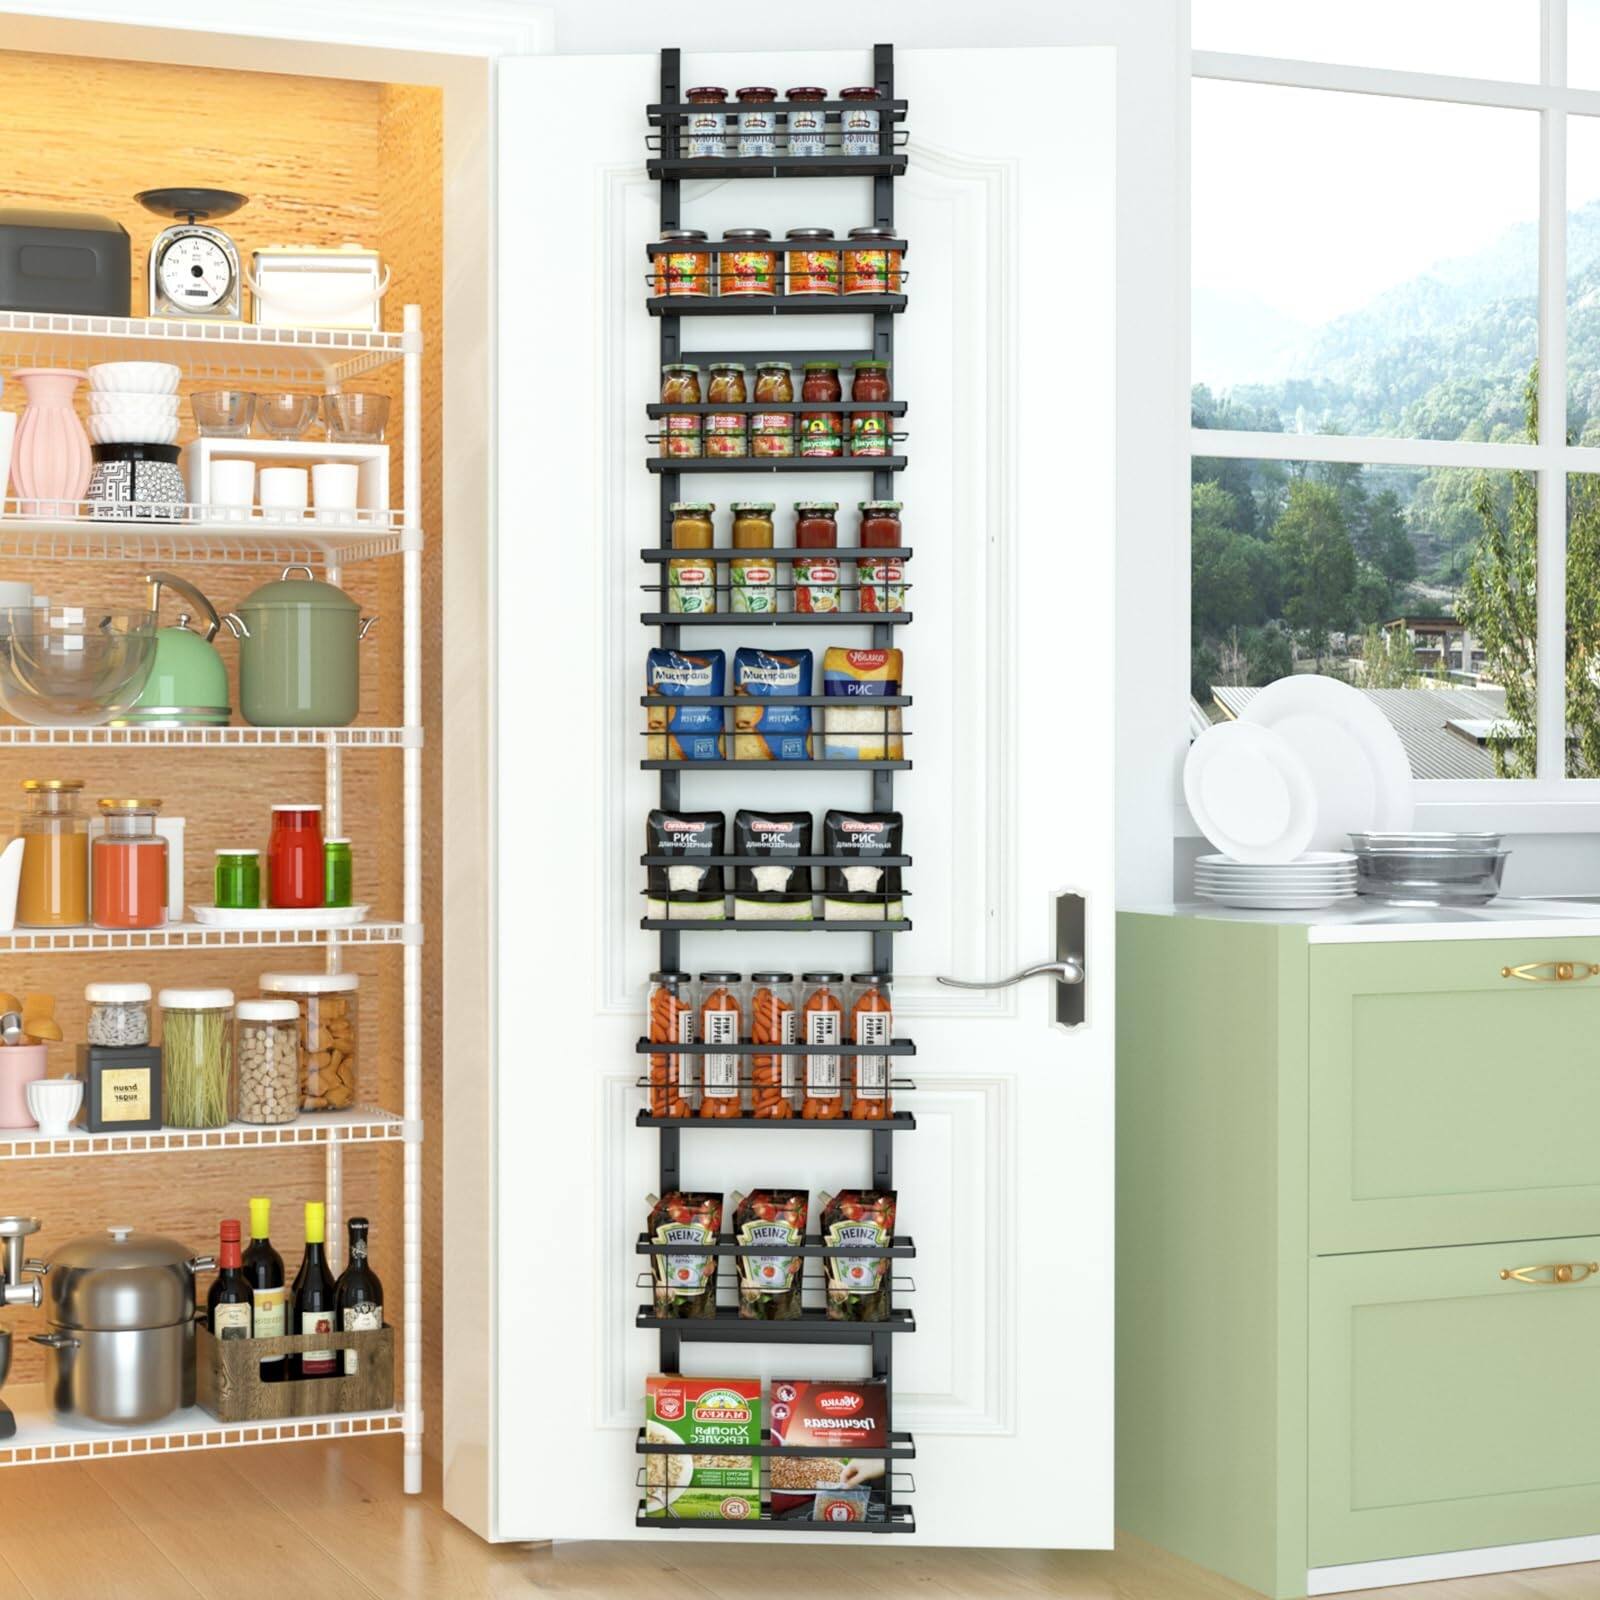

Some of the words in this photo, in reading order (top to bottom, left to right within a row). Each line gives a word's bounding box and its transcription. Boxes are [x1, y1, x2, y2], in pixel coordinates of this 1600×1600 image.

[848, 684, 873, 695] РИС
[673, 833, 697, 843] РИС
[761, 833, 785, 843] РИС
[851, 833, 876, 843] РИС
[713, 1017, 722, 1044] PEPPER
[816, 1017, 824, 1044] PEPPER
[825, 1017, 833, 1035] PINK
[866, 1018, 875, 1044] PEPPER
[875, 1018, 883, 1035] PINK
[668, 1230, 702, 1242] HEINZ
[753, 1227, 787, 1240] HEINZ
[841, 1227, 876, 1240] HEINZ
